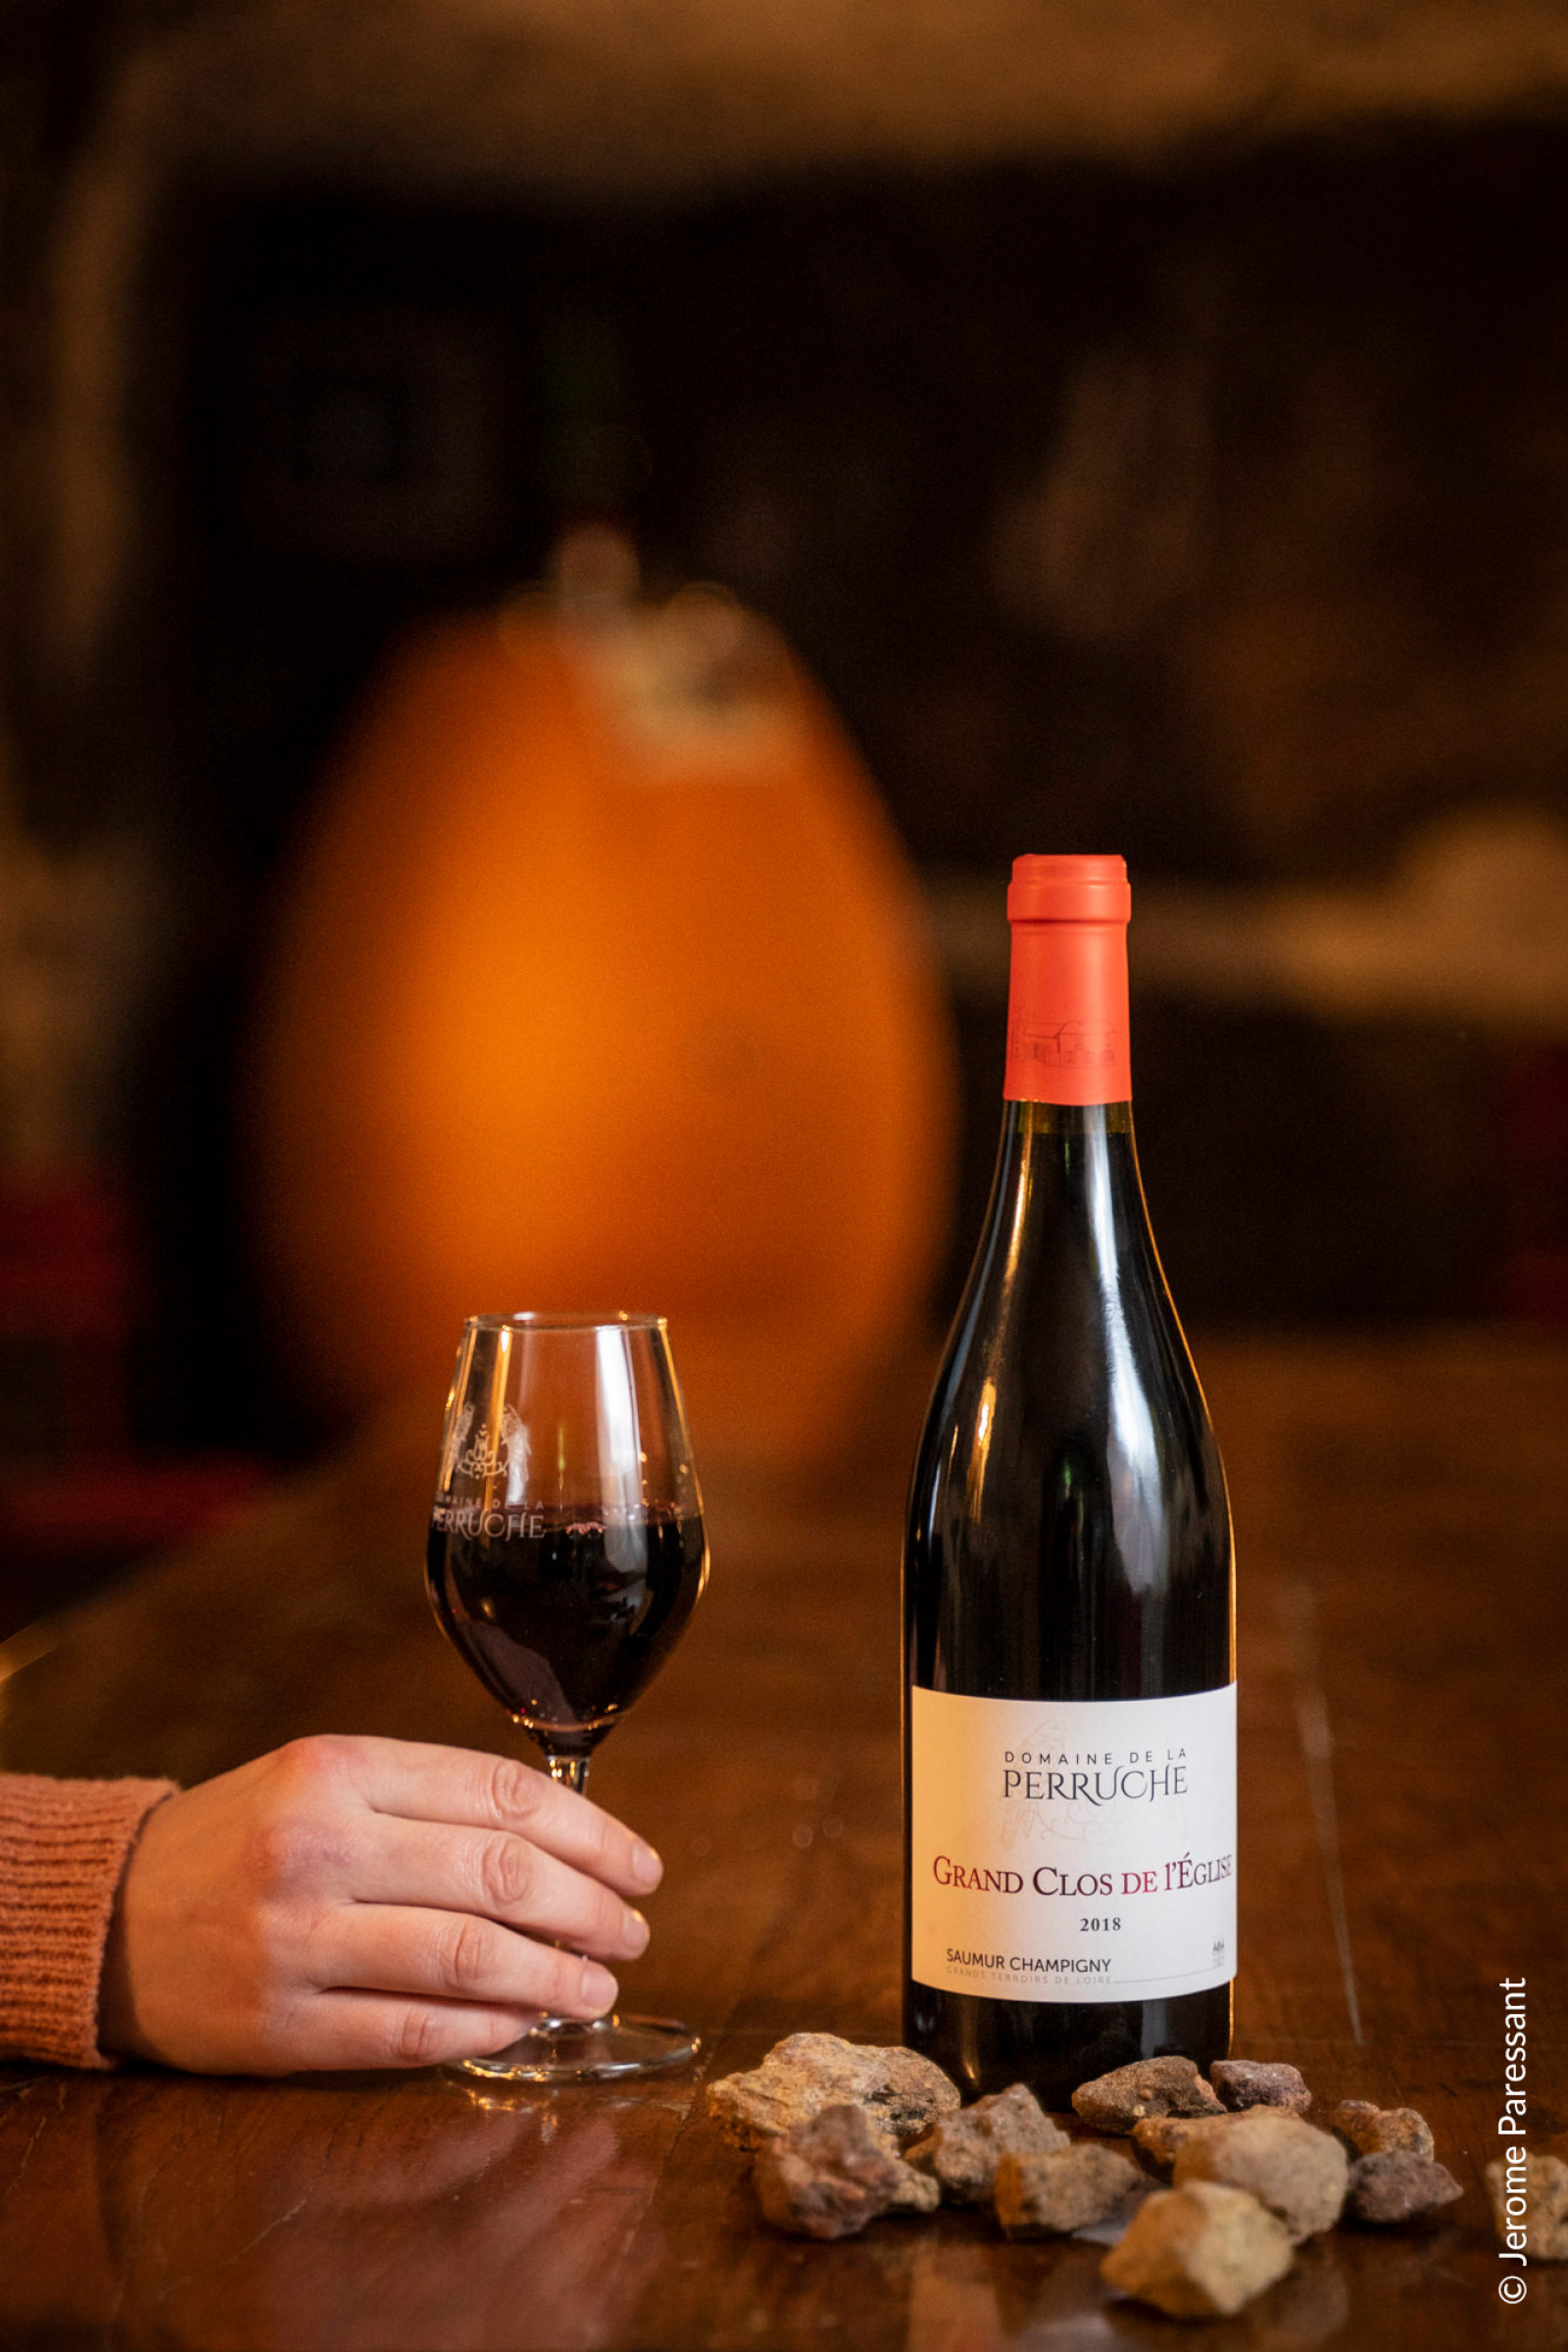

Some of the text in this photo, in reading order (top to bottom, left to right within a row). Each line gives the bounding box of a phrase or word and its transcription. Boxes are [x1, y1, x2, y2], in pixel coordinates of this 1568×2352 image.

[1004, 1747, 1187, 1765] DOMAINE DE LA
[1003, 1764, 1188, 1806] PERRUCHE
[1121, 1871, 1157, 1894] DE
[1080, 1917, 1121, 1932] 2018
[947, 1948, 1111, 1973] SAUMUR CHAMPIGNY
[1054, 1976, 1069, 1985] DE
[1077, 1976, 1111, 1985] LOIRE
